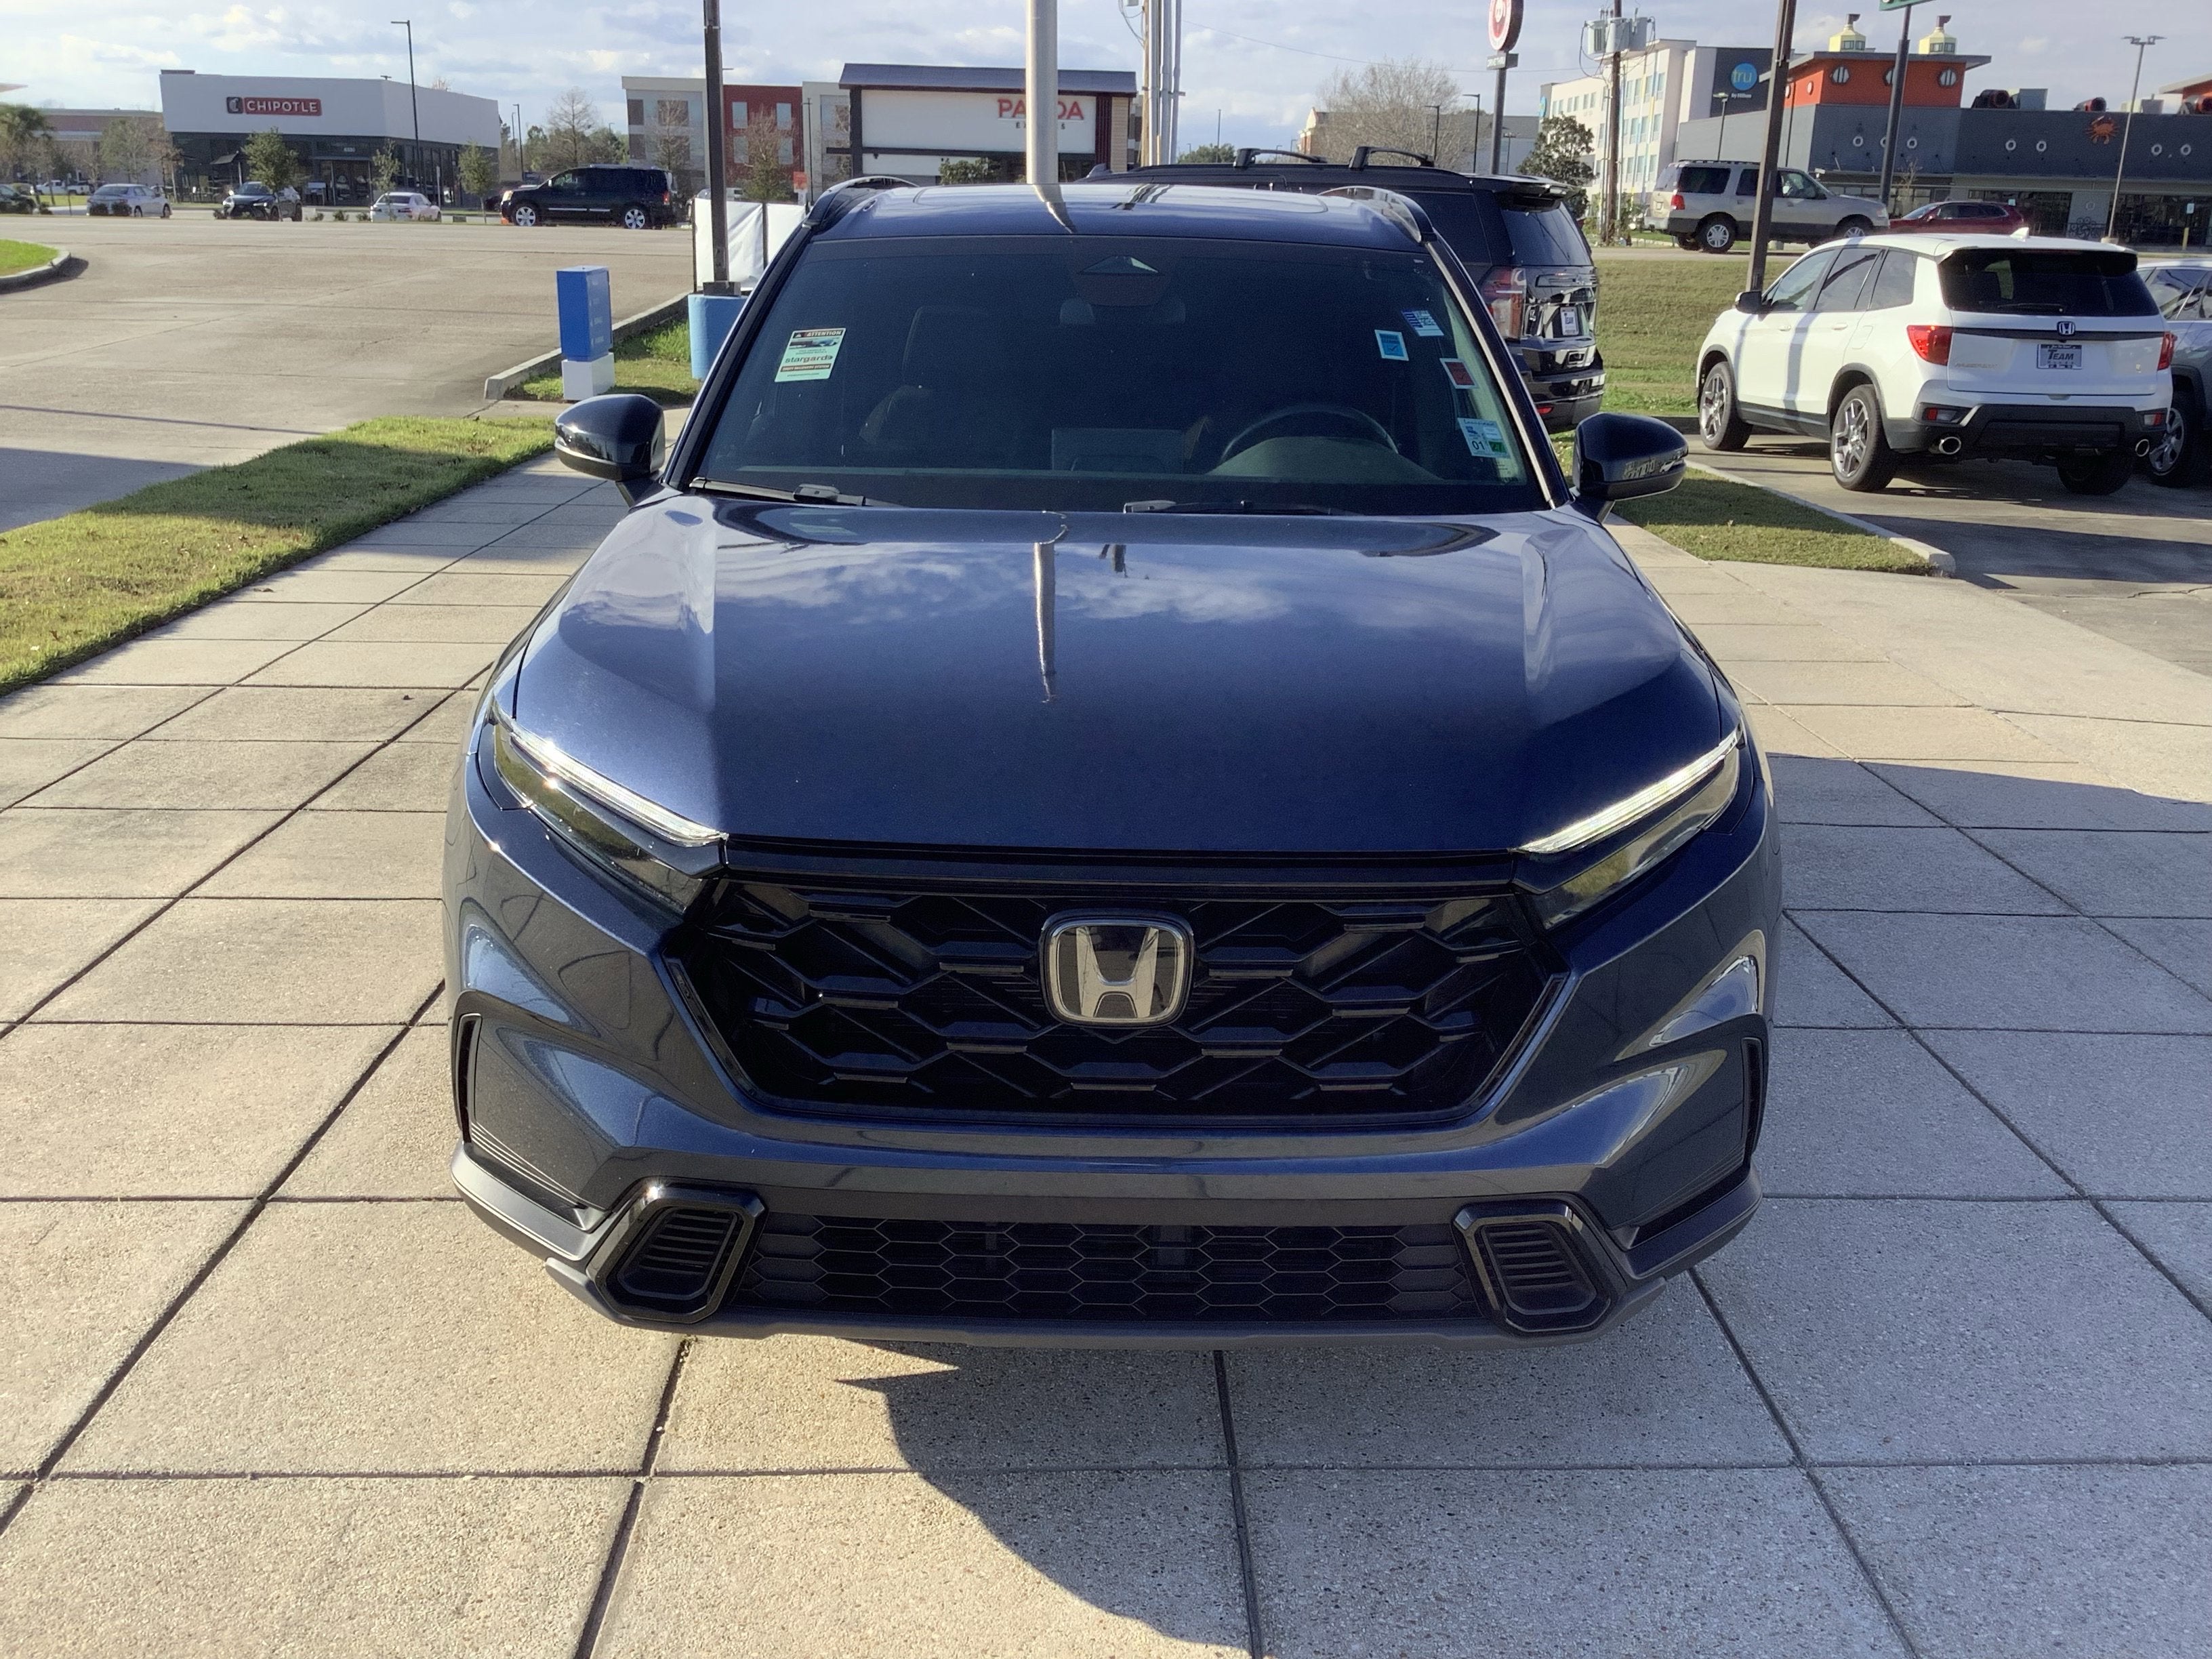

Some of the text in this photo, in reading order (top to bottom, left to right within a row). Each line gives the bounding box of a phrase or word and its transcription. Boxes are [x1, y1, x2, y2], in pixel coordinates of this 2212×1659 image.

[247, 100, 318, 112] CHIPOTLE
[998, 99, 1084, 120] PADA
[1471, 441, 1486, 450] 01
